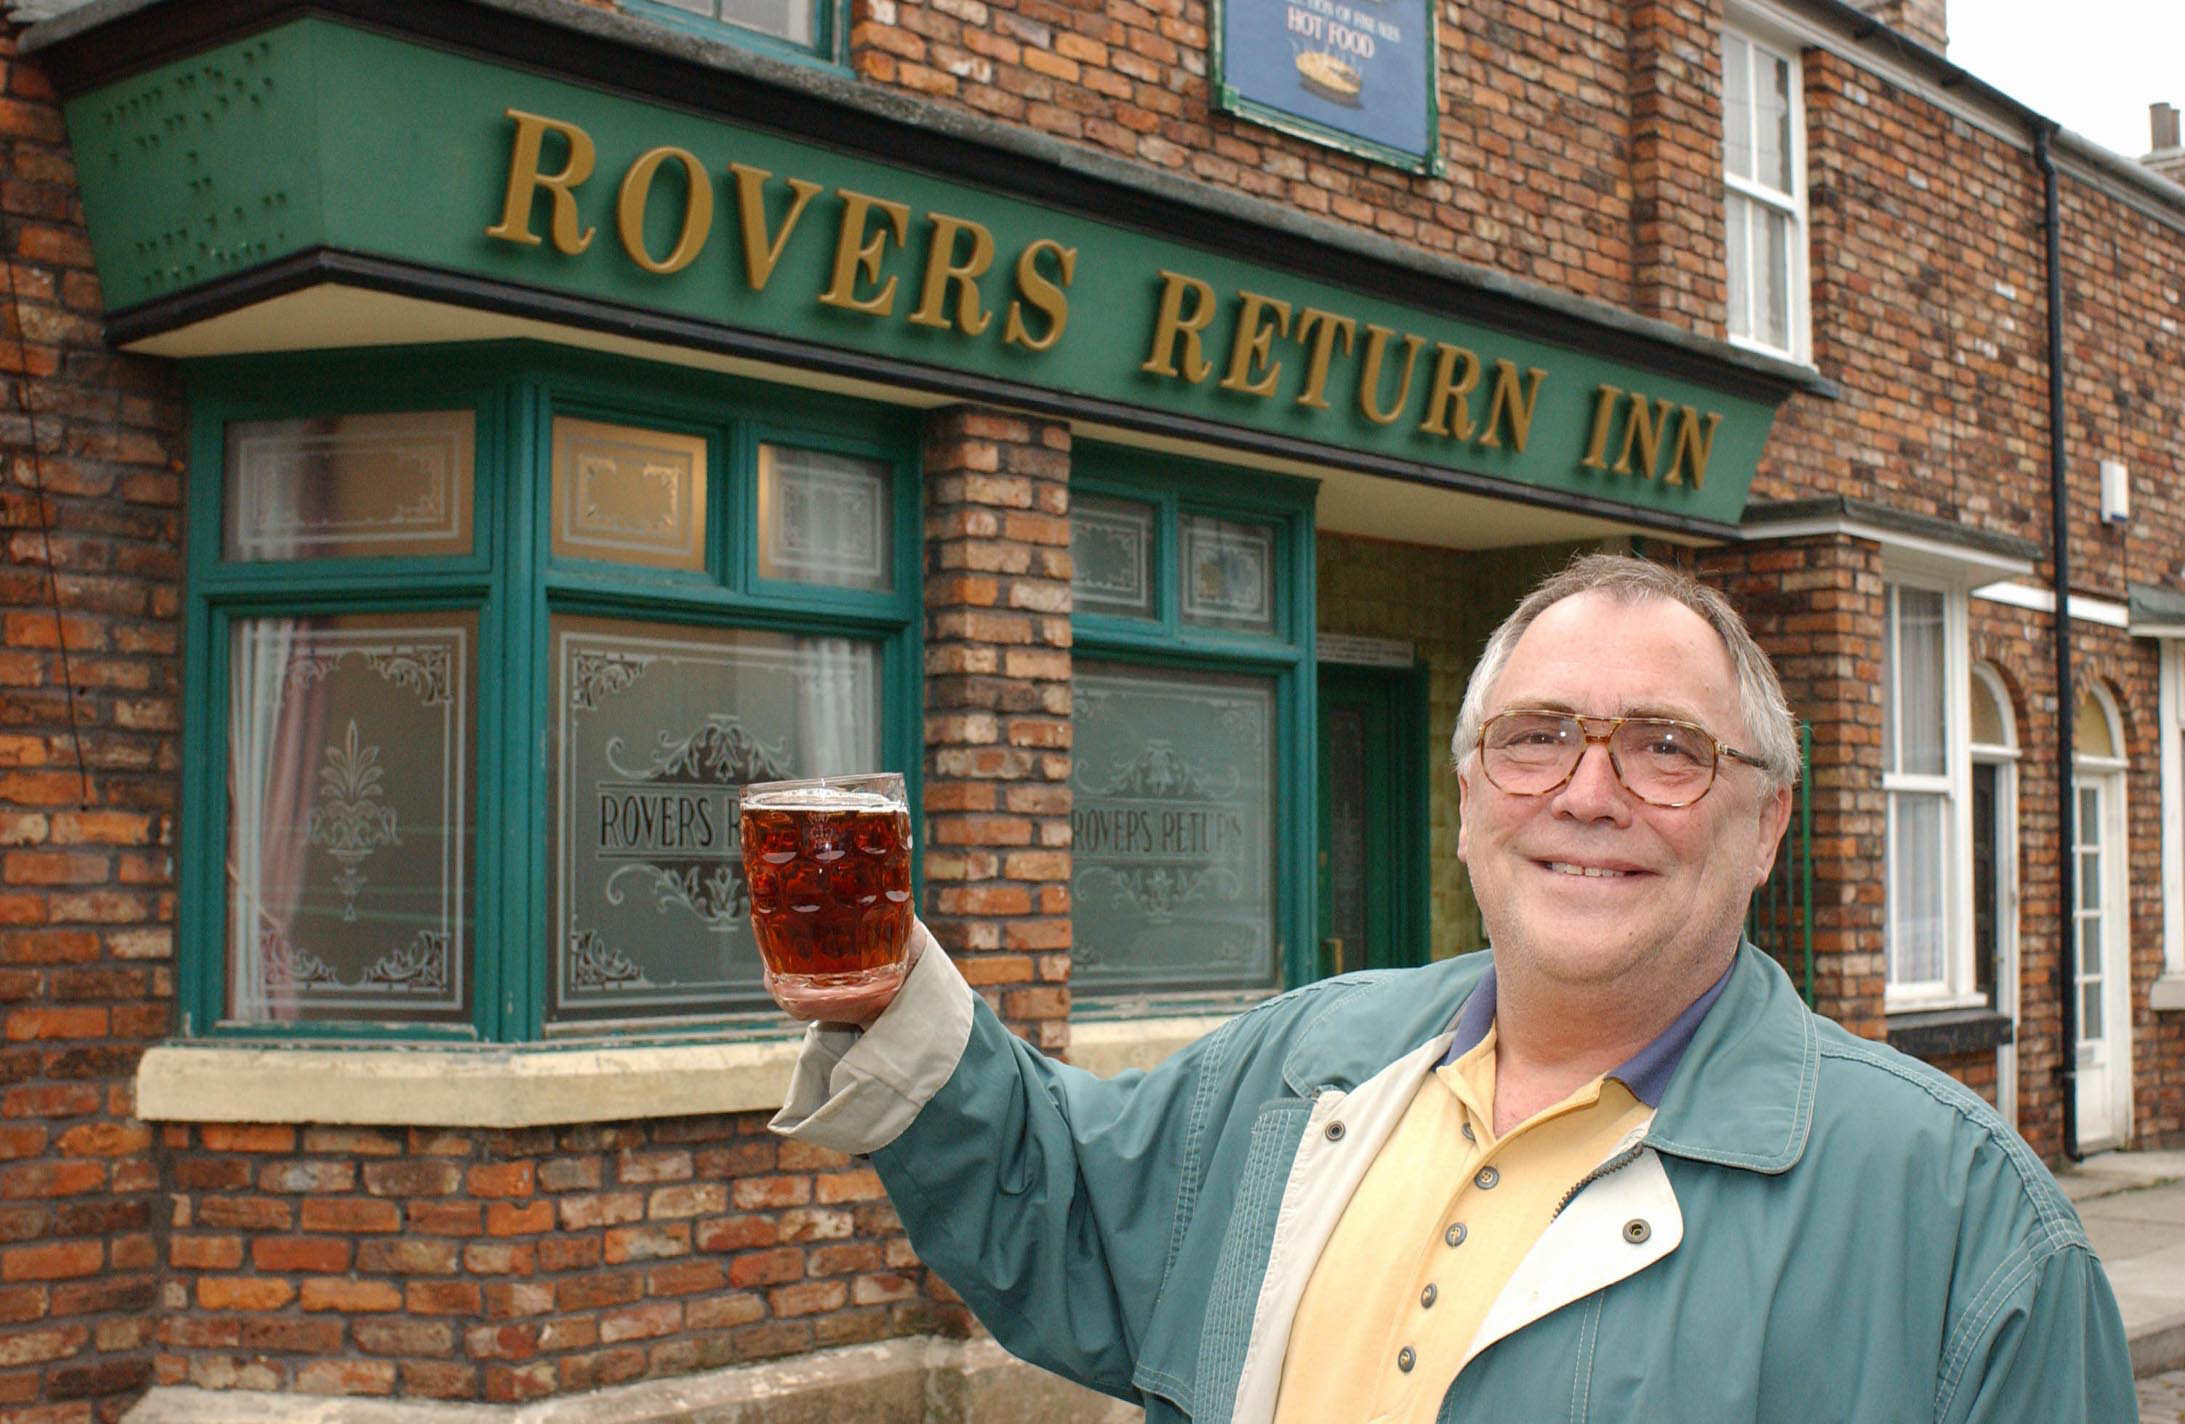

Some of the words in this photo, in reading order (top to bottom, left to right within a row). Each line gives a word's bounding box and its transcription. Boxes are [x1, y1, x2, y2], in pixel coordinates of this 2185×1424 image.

[1287, 5, 1322, 40] HOT
[1328, 21, 1375, 59] FOOD
[485, 108, 1077, 353] ROVERS
[1141, 269, 1548, 454] RETURN
[1581, 384, 1723, 490] INN
[601, 795, 713, 847] ROVERS
[1071, 808, 1152, 853] ROVERS
